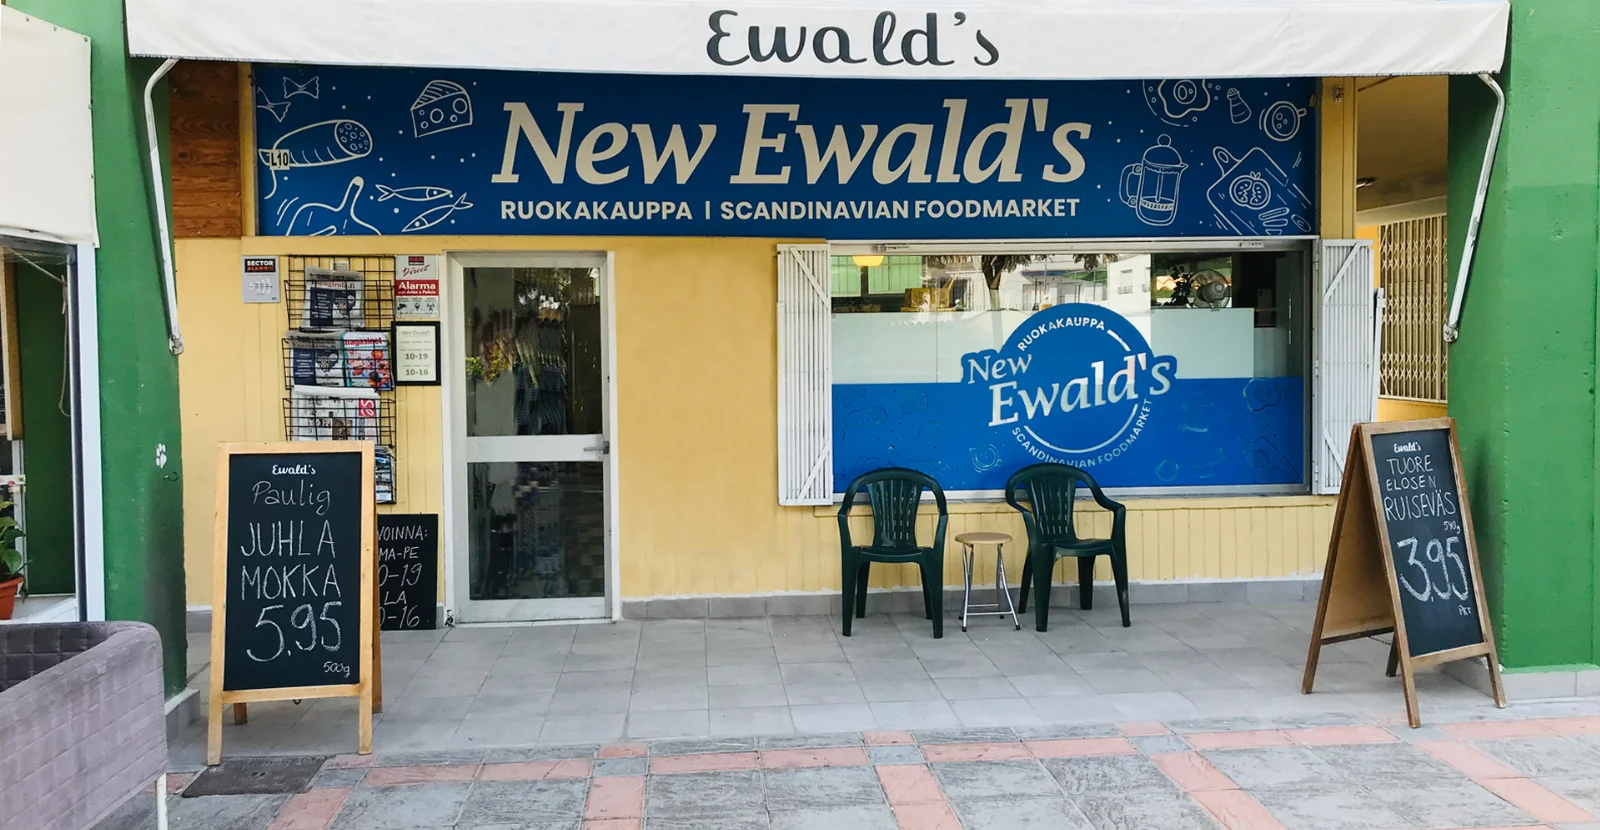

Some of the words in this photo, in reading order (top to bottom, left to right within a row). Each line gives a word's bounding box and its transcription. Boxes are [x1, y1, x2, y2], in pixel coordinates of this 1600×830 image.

[706, 9, 1000, 67] Ewald's
[491, 101, 718, 186] New
[729, 97, 1092, 185] Ewald's
[271, 152, 289, 166] L10
[500, 200, 693, 220] RUOKAKAUPPA
[720, 200, 909, 220] SCANDINAVIAN
[914, 198, 1080, 219] FOODMARKET
[402, 264, 431, 277] Direct
[398, 281, 436, 290] Alarma
[1017, 316, 1105, 352] RUOKAKAUPPA
[967, 353, 1033, 385] New
[988, 352, 1171, 427] Ewald's
[1097, 398, 1153, 465] FOODMARKET
[1394, 441, 1422, 453] Ewald's
[272, 464, 316, 475] Ewald's
[1386, 454, 1434, 475] TUORE
[1386, 475, 1437, 492] ELOSEN
[252, 479, 331, 516] Paulig
[1383, 489, 1457, 522] RUISEVÄS
[240, 519, 336, 558] JUHLA
[378, 525, 428, 541] VOINNA:
[378, 546, 419, 561] MA-PE
[241, 563, 342, 601] MOKKA
[378, 562, 423, 587] 0-19
[384, 590, 407, 605] LA
[379, 605, 421, 629] 0-16
[322, 661, 351, 678] 500g
